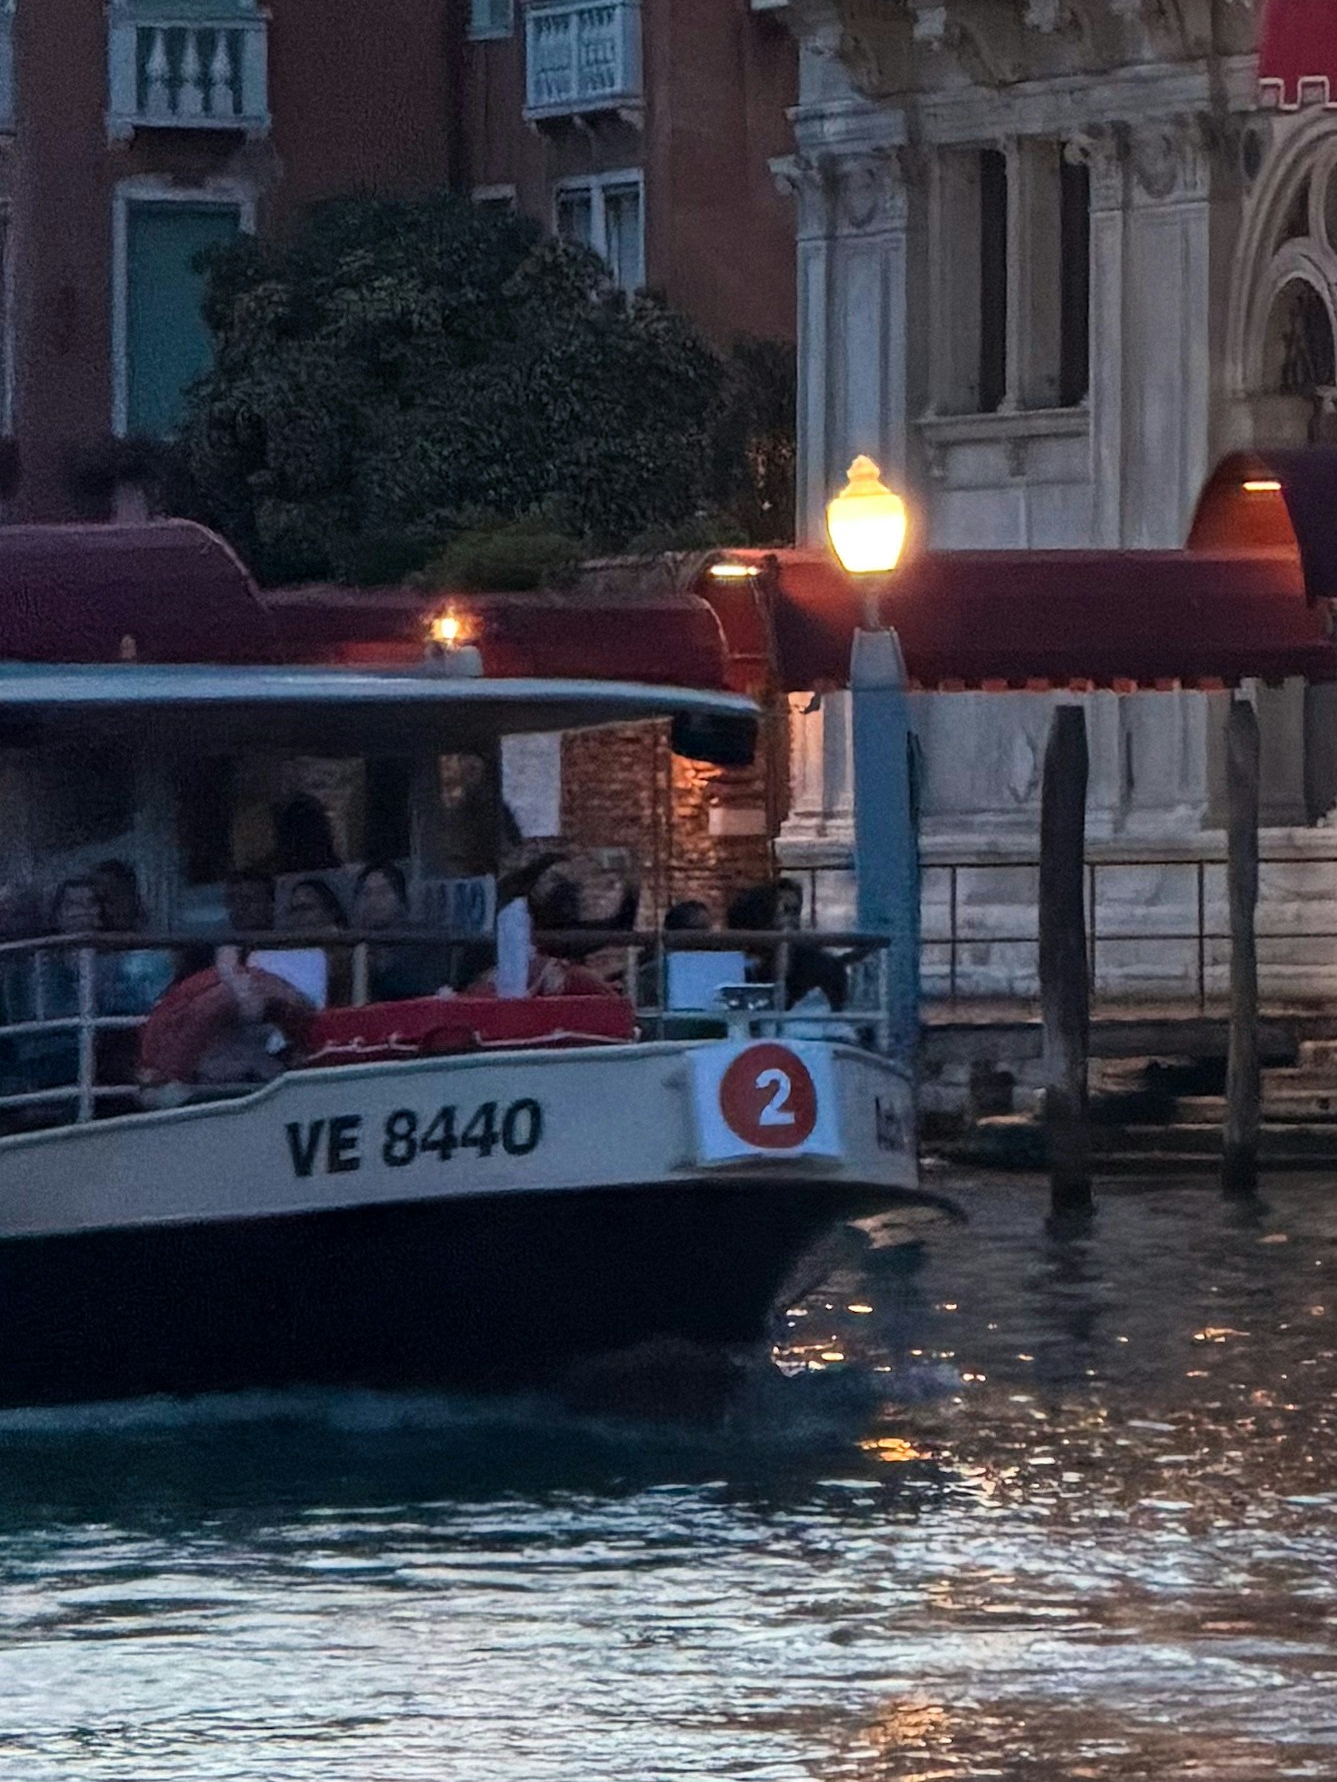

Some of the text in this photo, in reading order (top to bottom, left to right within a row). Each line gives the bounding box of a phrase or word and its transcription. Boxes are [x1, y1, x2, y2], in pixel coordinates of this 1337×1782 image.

[754, 1068, 796, 1127] 2
[286, 1096, 544, 1177] VE 8440
